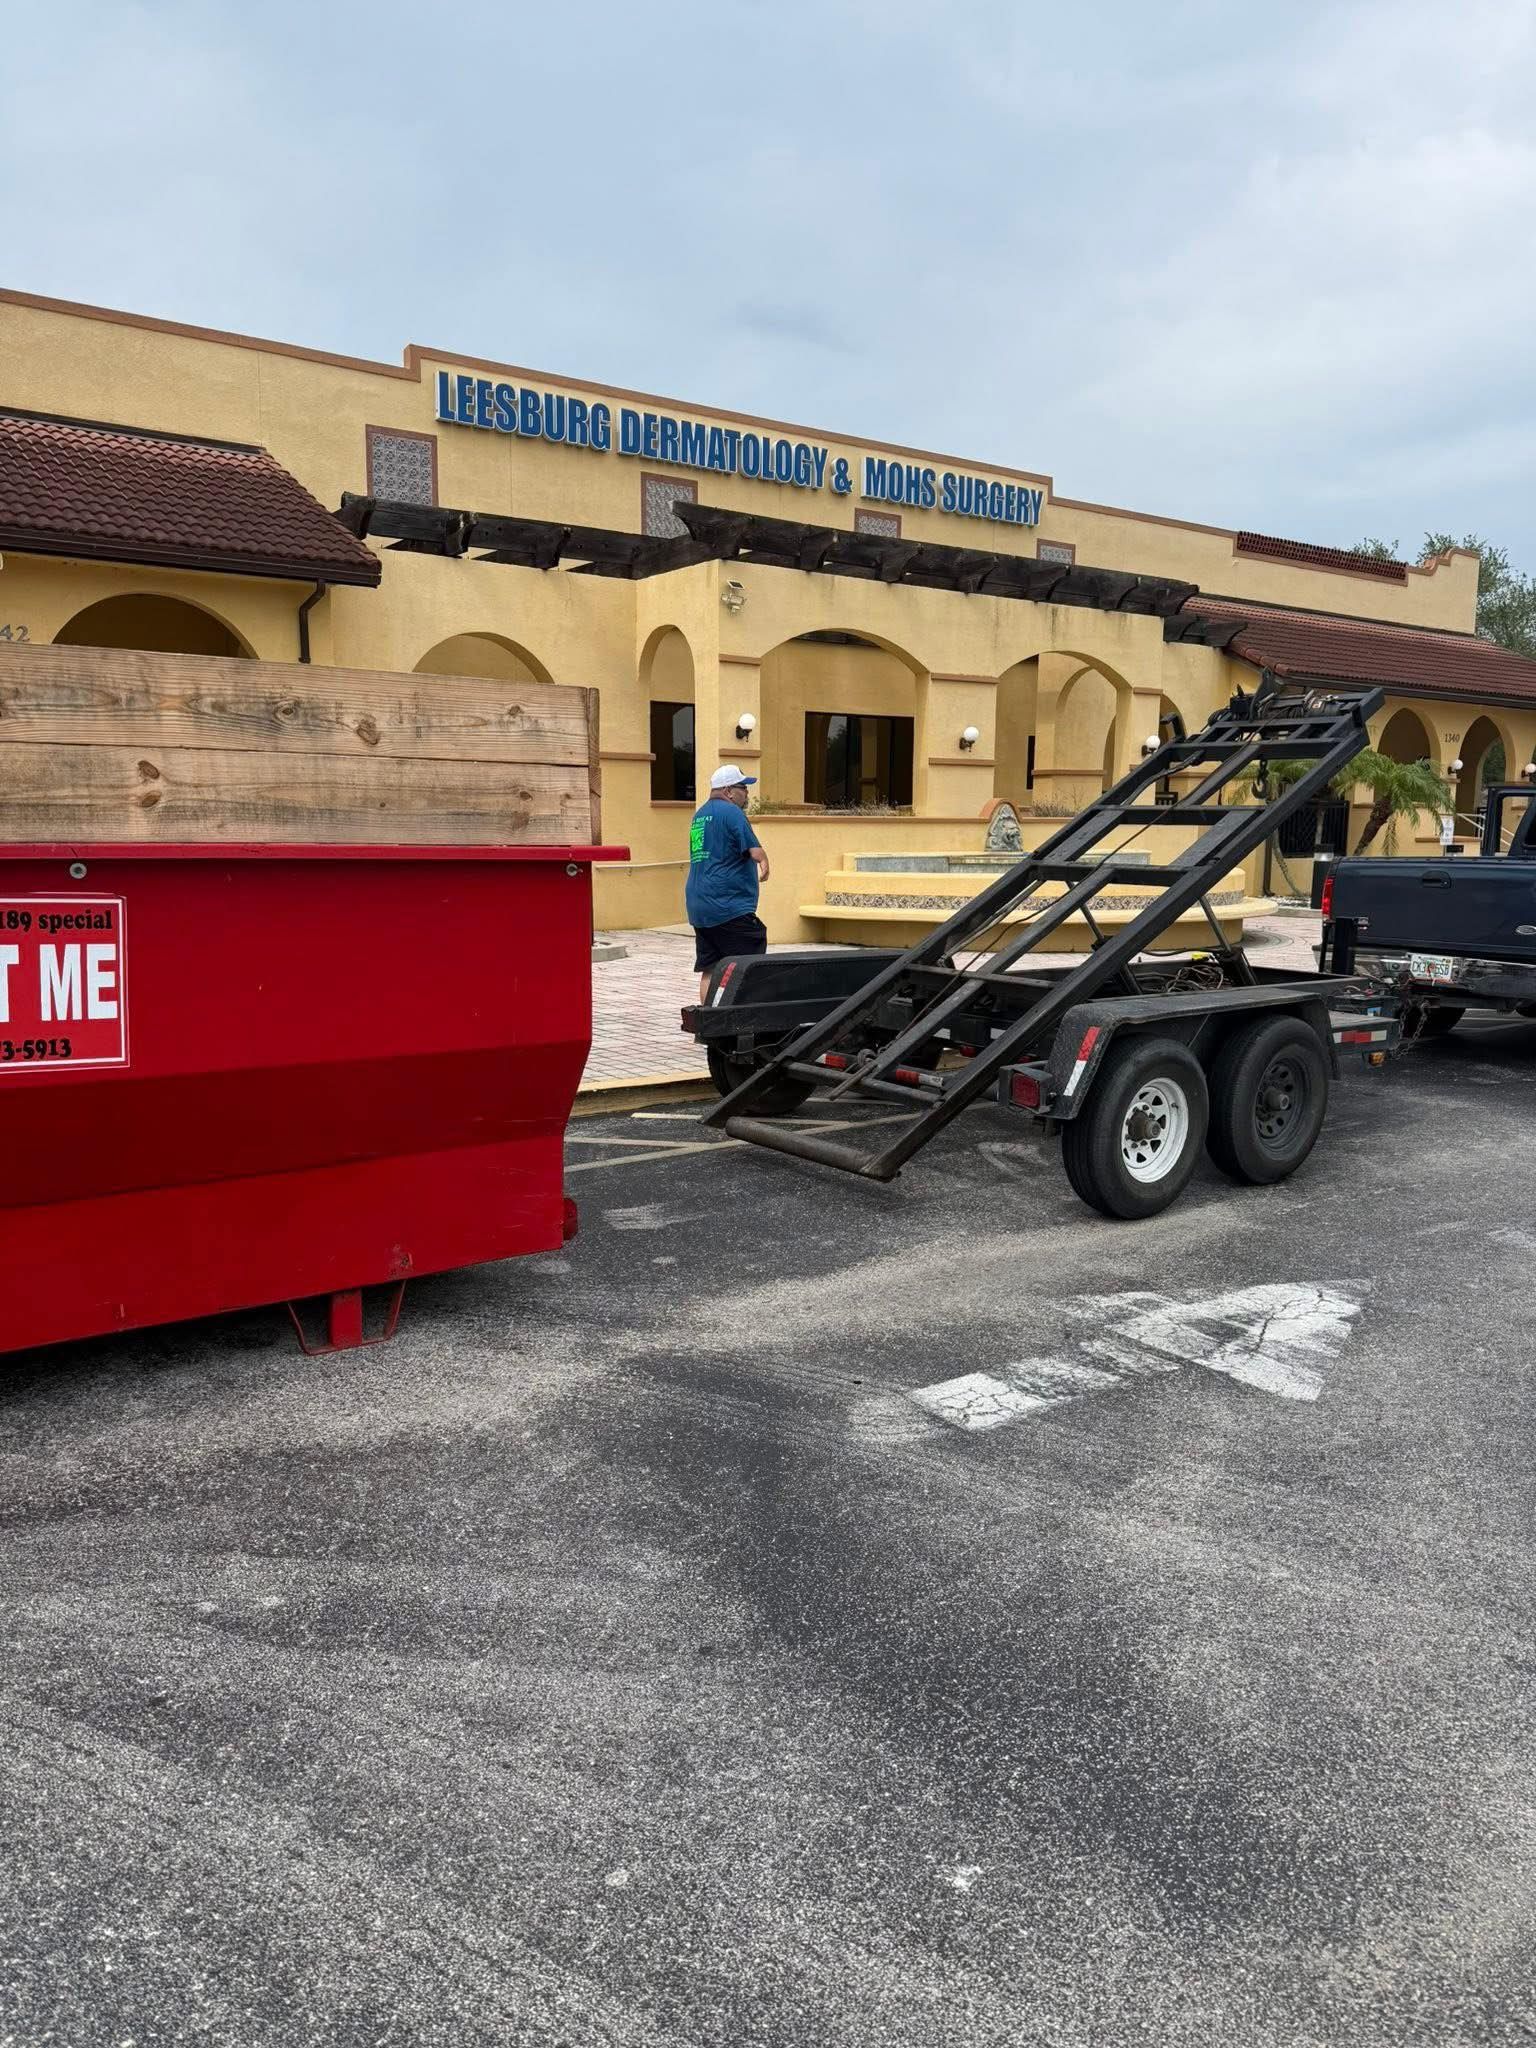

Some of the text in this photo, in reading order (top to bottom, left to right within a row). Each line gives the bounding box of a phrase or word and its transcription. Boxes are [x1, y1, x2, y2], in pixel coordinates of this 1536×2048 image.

[436, 371, 1044, 526] LEESBURG DERMATOLOGY & MOHS SURGERY
[38, 909, 113, 934] special
[40, 943, 118, 1022] ME
[0, 1038, 72, 1060] 3-5913
